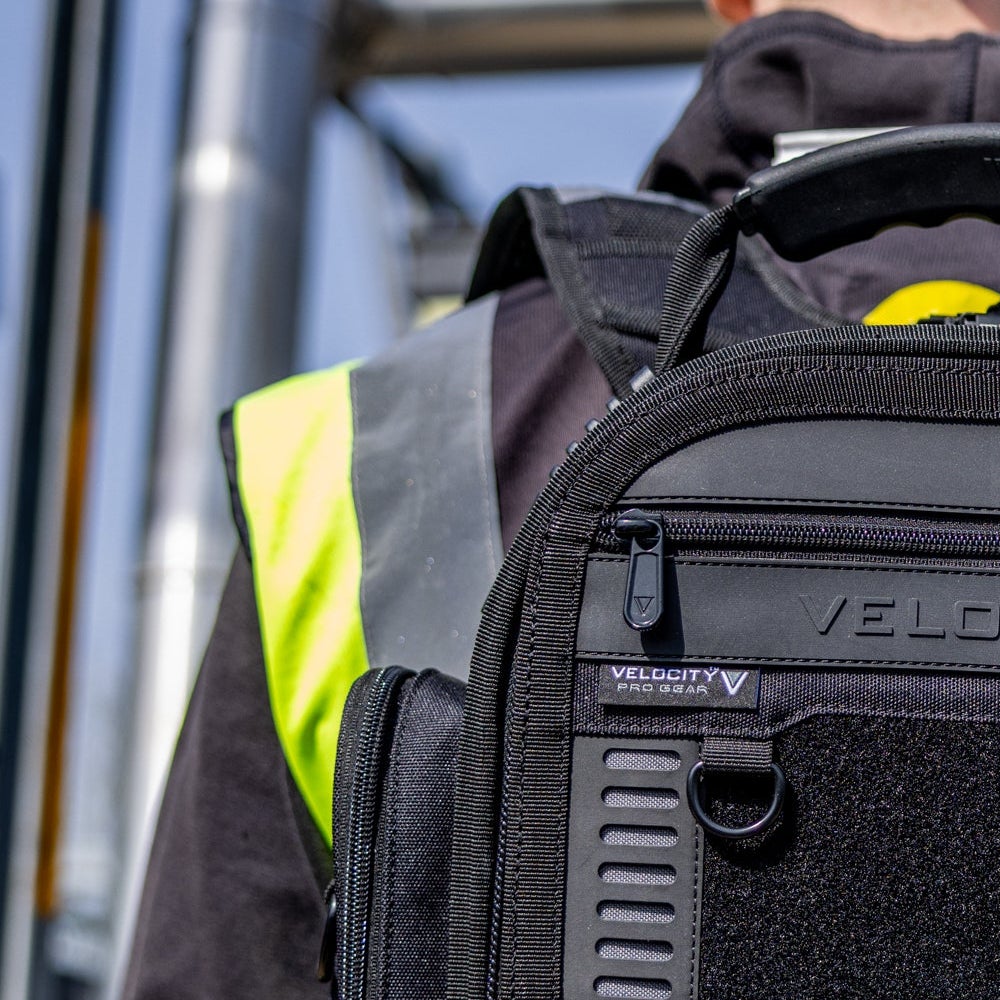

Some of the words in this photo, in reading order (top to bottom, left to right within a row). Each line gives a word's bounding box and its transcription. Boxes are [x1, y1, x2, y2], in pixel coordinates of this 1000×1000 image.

[611, 666, 718, 682] VELOCITY
[617, 682, 653, 693] PRO
[659, 684, 708, 695] GEAR
